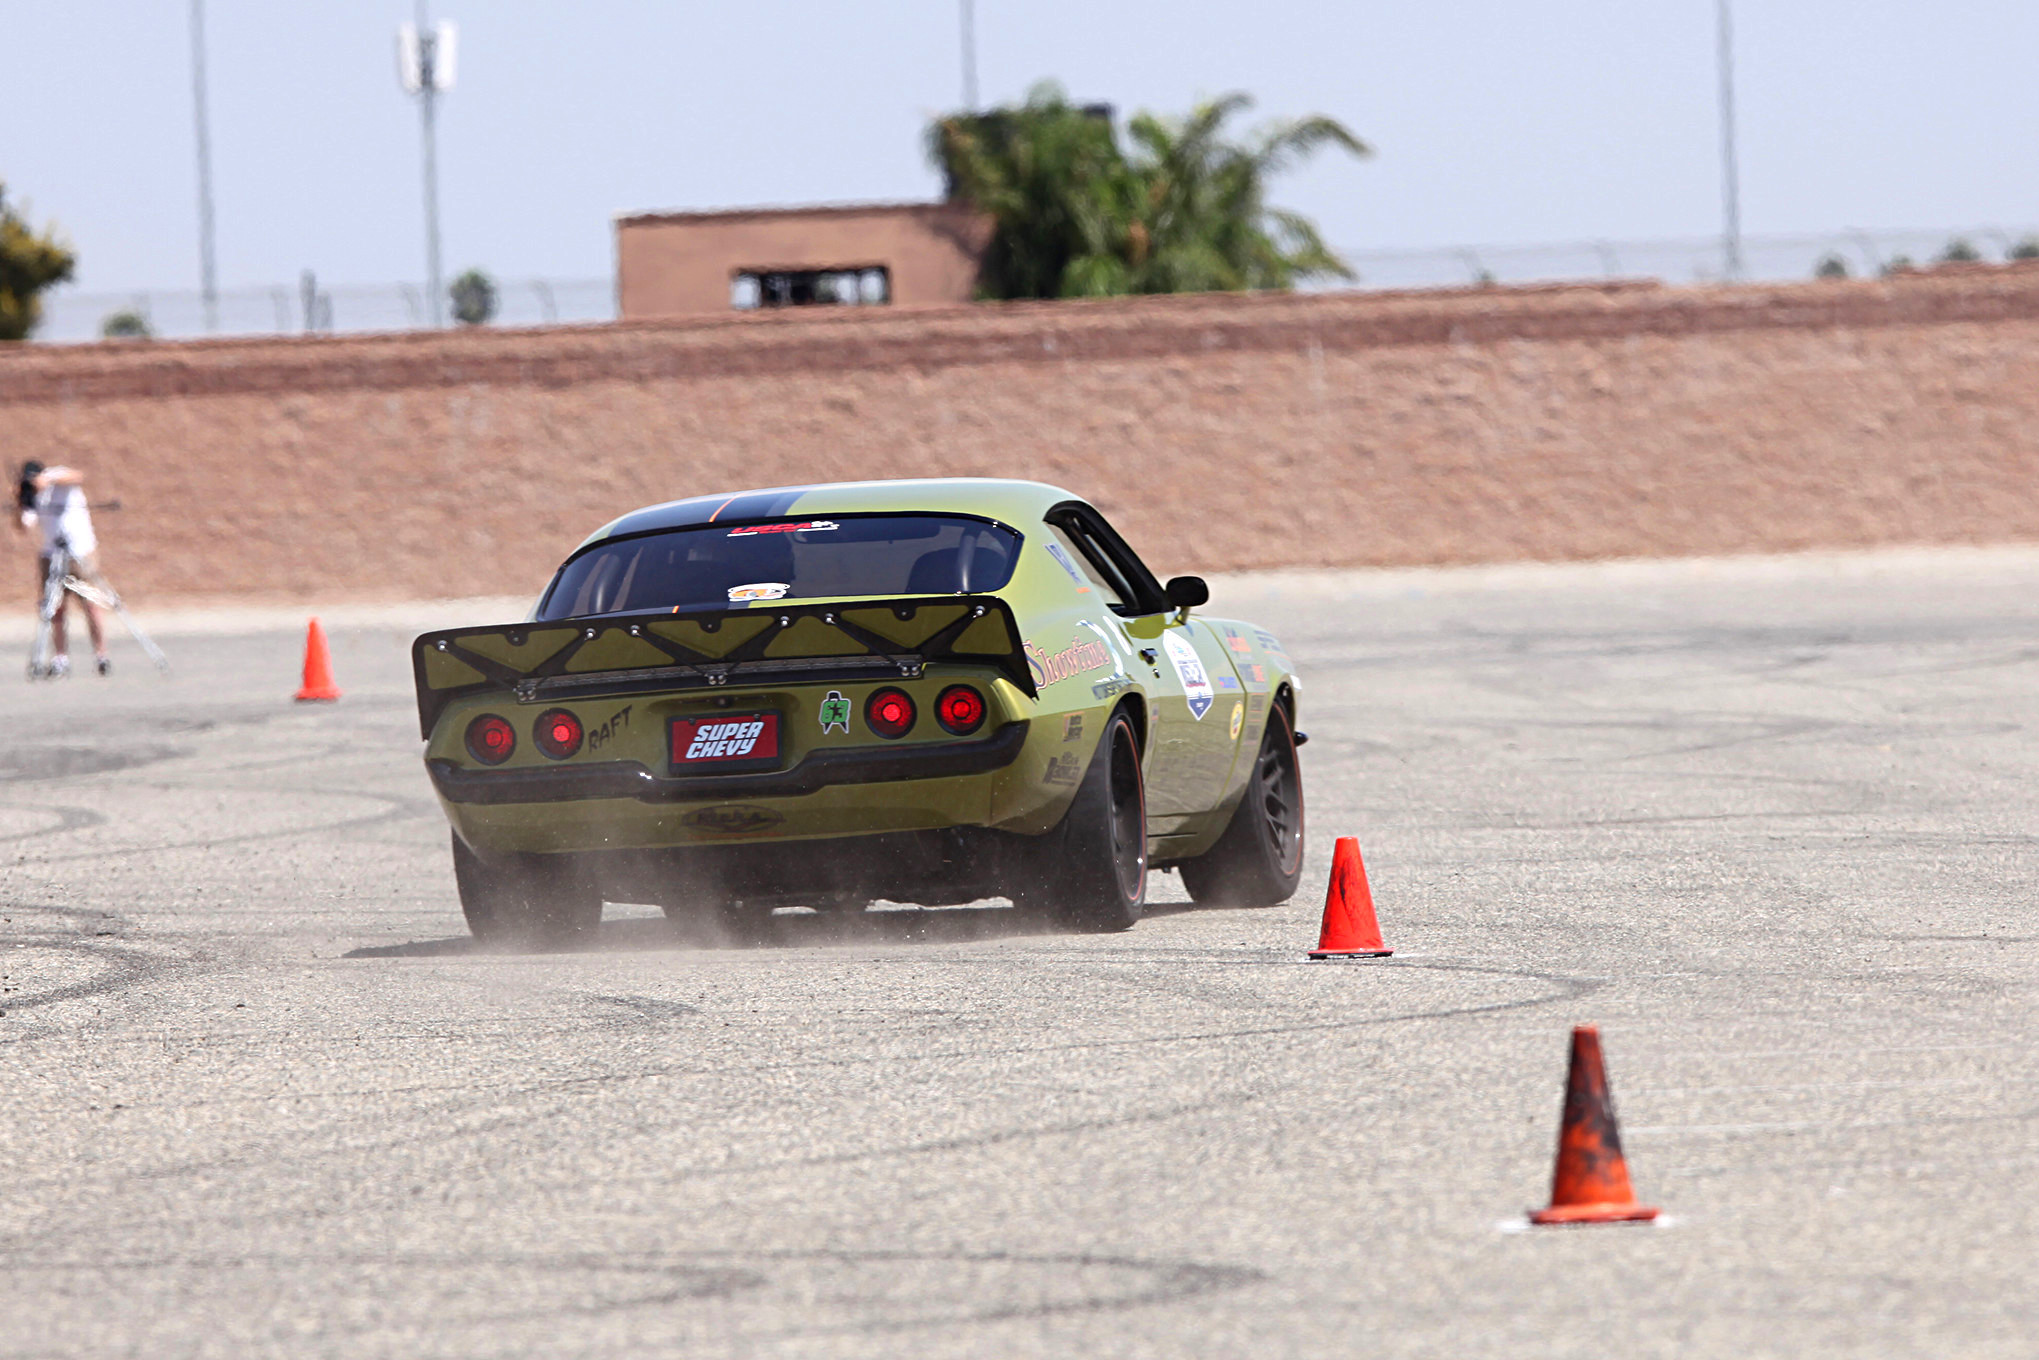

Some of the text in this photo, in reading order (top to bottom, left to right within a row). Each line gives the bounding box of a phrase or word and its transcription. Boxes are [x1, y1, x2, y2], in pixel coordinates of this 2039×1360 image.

[588, 704, 633, 754] RAFT
[694, 721, 764, 742] SUPER
[685, 739, 756, 759] CHEVY
